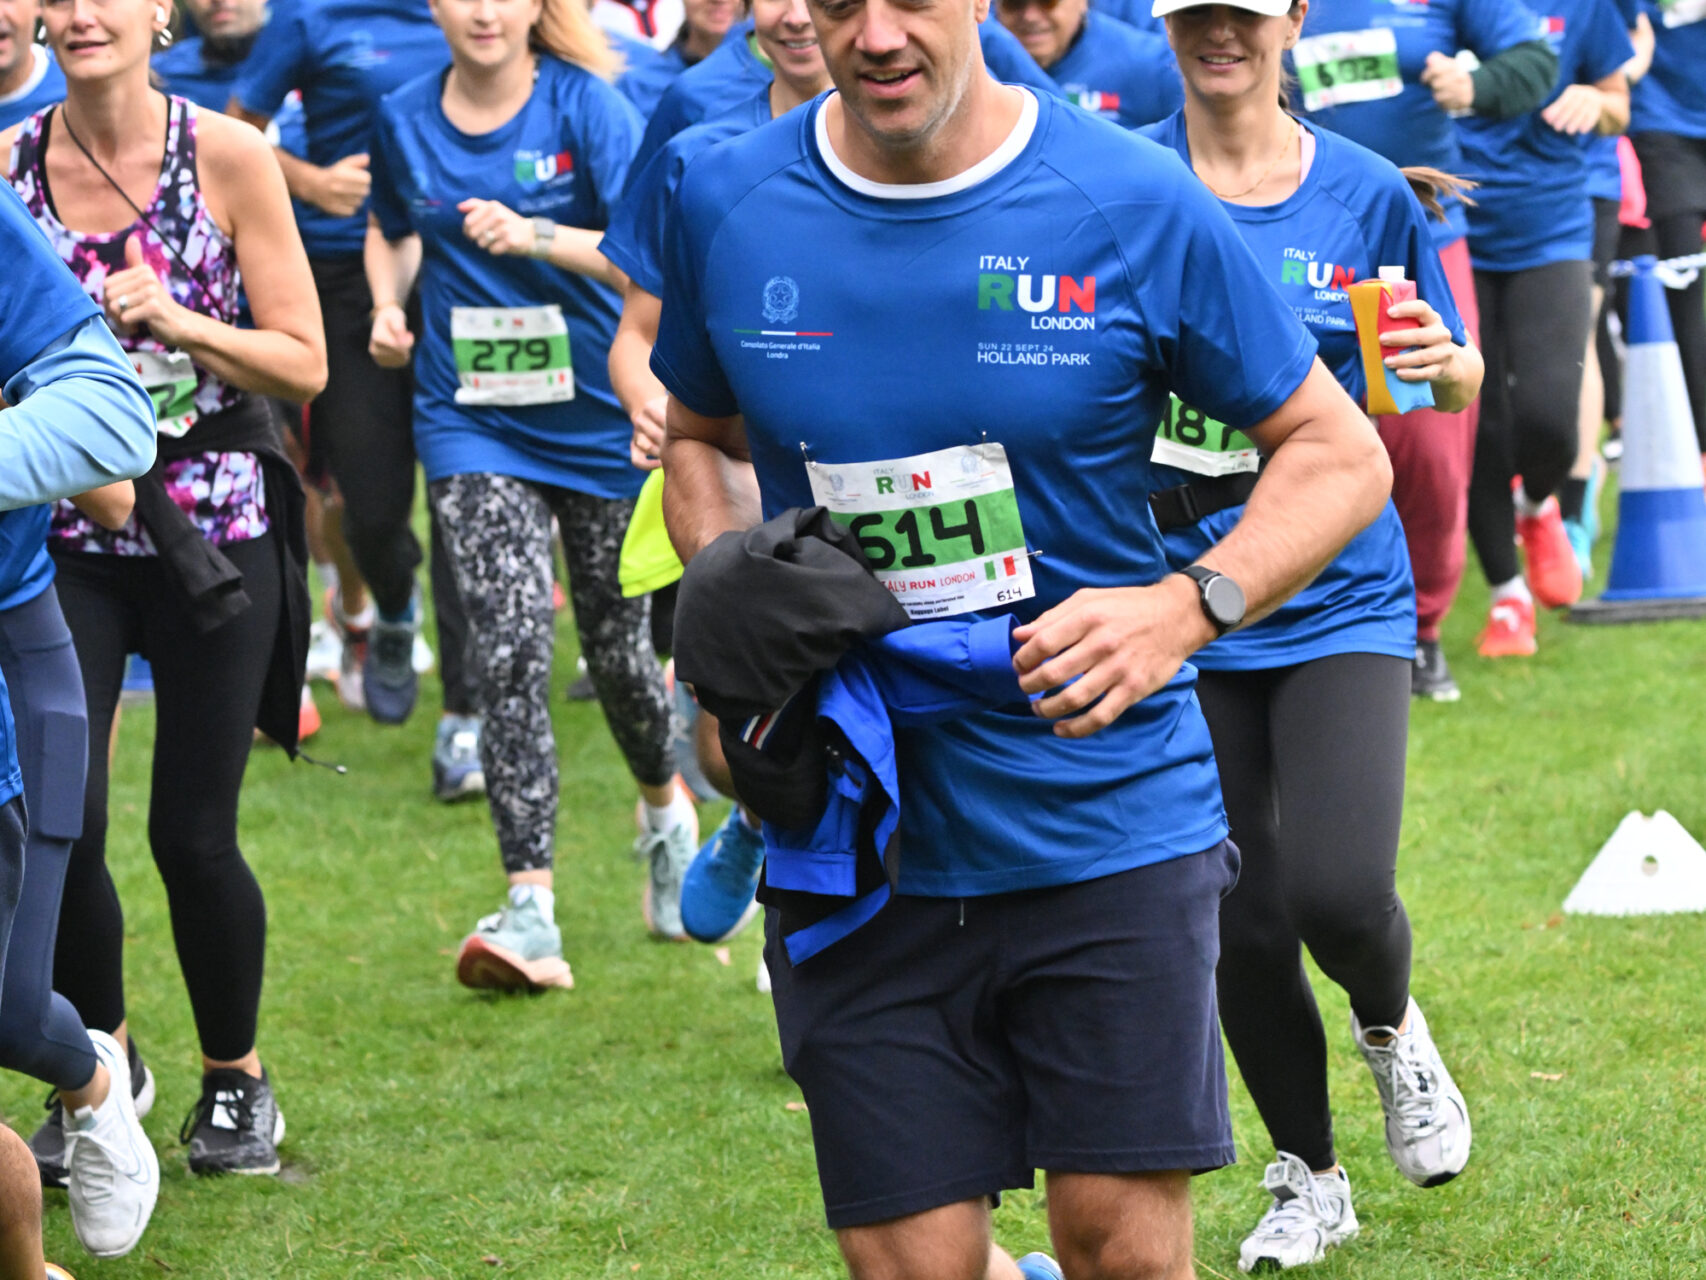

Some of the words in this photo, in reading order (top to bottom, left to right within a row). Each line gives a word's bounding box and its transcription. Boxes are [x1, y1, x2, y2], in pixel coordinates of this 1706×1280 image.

[1284, 247, 1316, 261] ITALY
[979, 255, 1030, 271] ITALY
[1281, 259, 1355, 292] RUN
[977, 273, 1096, 313] RUN
[1031, 316, 1095, 330] LONDON
[472, 338, 551, 372] 279
[767, 351, 789, 359] Londra
[978, 342, 998, 351] SUN
[1001, 343, 1012, 352] 22
[1015, 343, 1040, 352] SEPT
[1043, 344, 1054, 353] 24
[977, 351, 1048, 365] HOLLAND
[1051, 353, 1091, 366] PARK
[873, 467, 894, 475] ITALY
[875, 470, 932, 495] RUN
[849, 499, 985, 570] 614
[880, 580, 907, 593] ALY
[909, 579, 936, 591] RUN
[940, 571, 976, 588] LONDON
[996, 586, 1023, 602] 614
